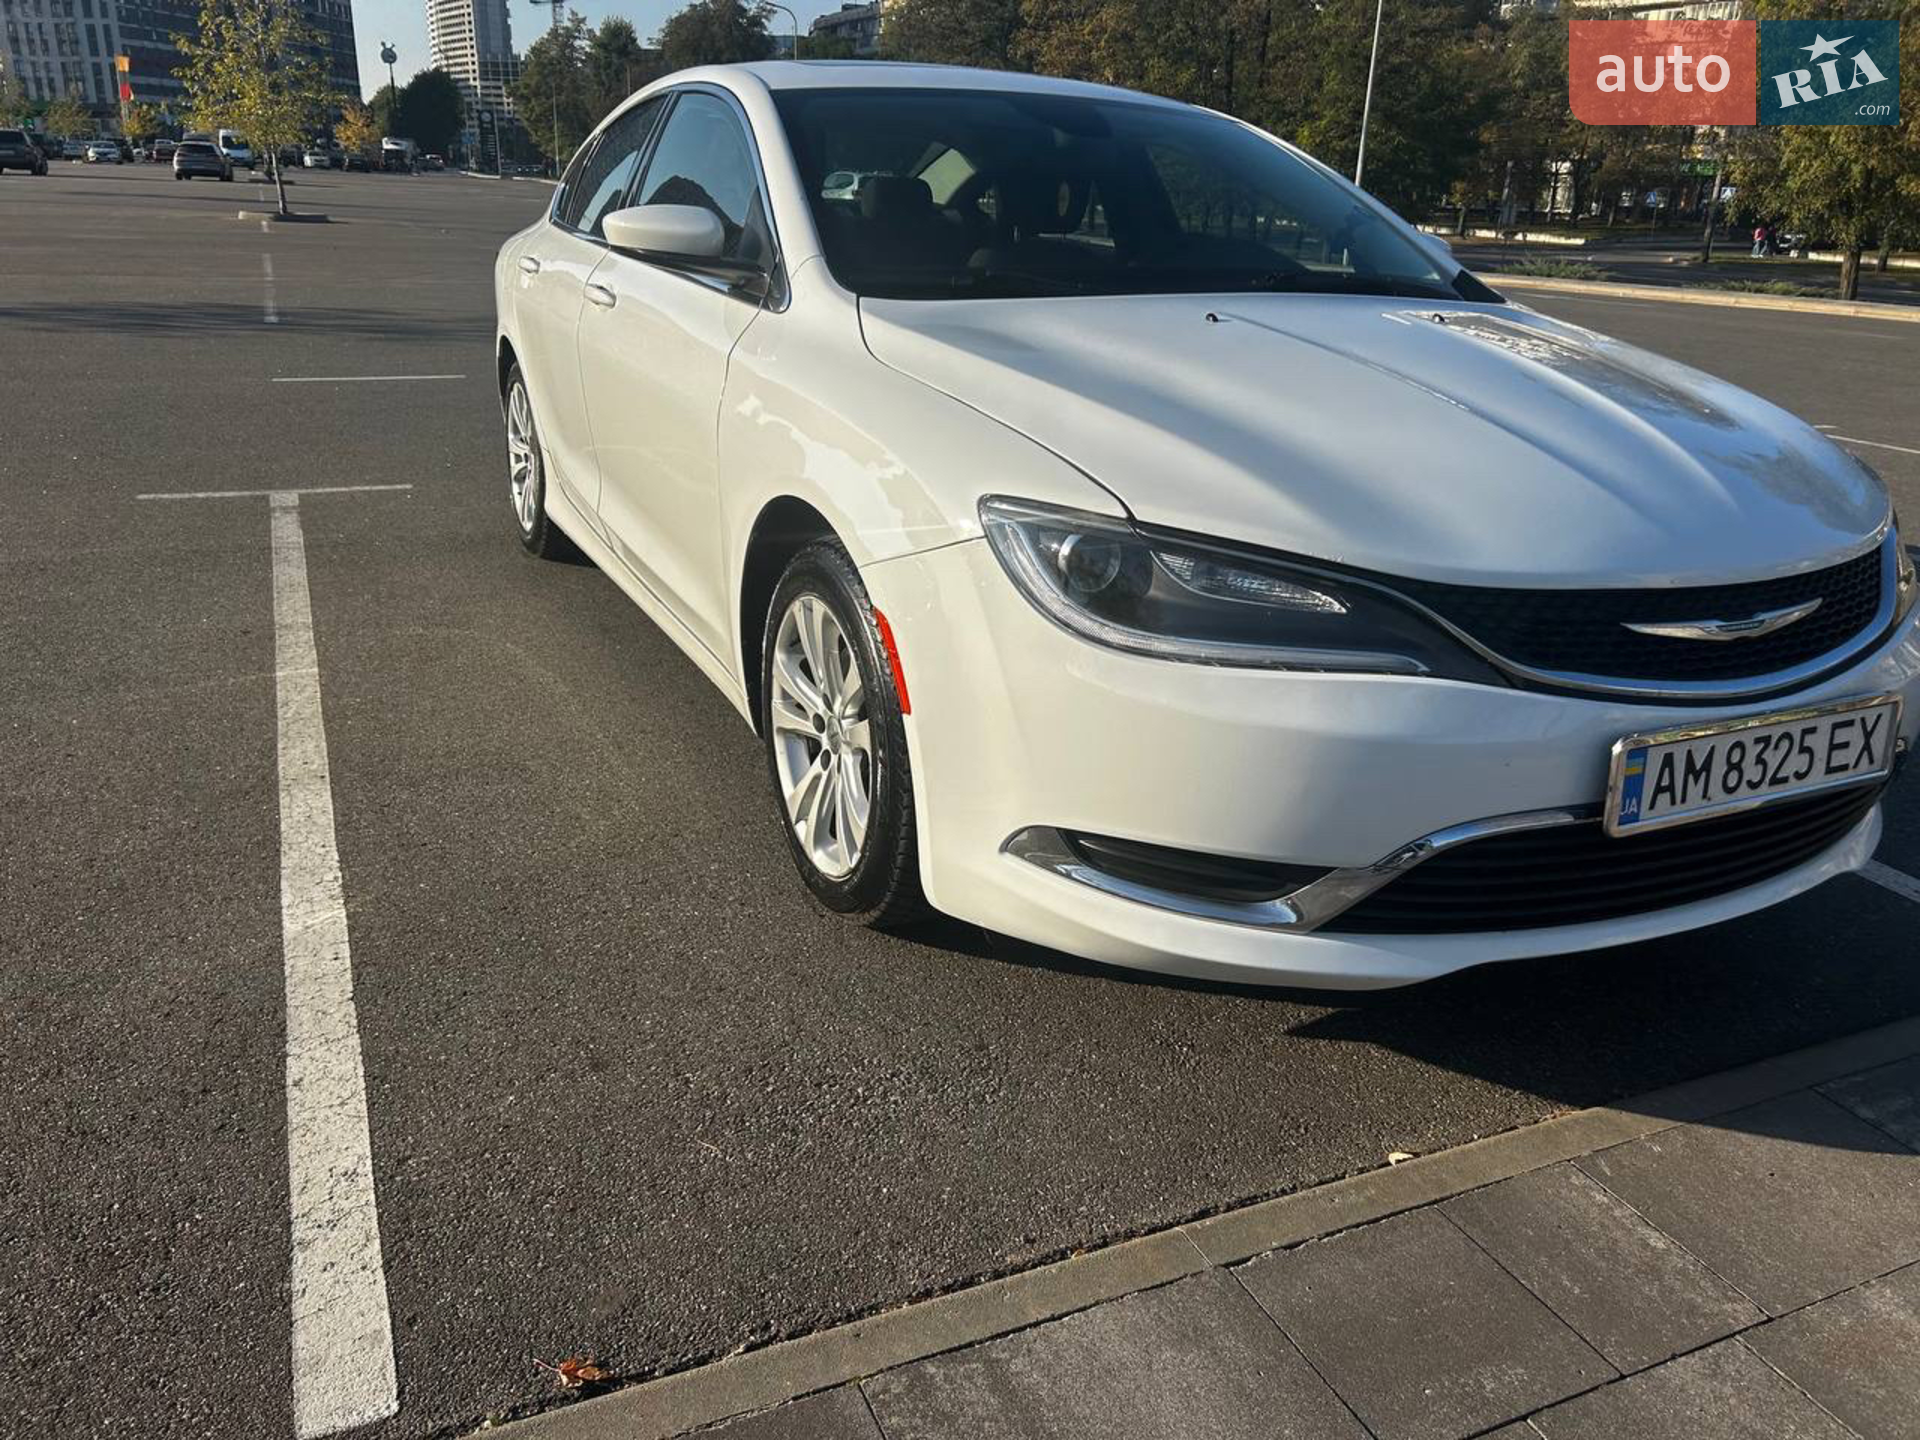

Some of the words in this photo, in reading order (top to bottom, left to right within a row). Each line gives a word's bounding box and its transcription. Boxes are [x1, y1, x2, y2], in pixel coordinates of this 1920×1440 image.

[1648, 744, 1716, 810] AM
[1721, 726, 1818, 795] 8325
[1824, 713, 1883, 775] EX
